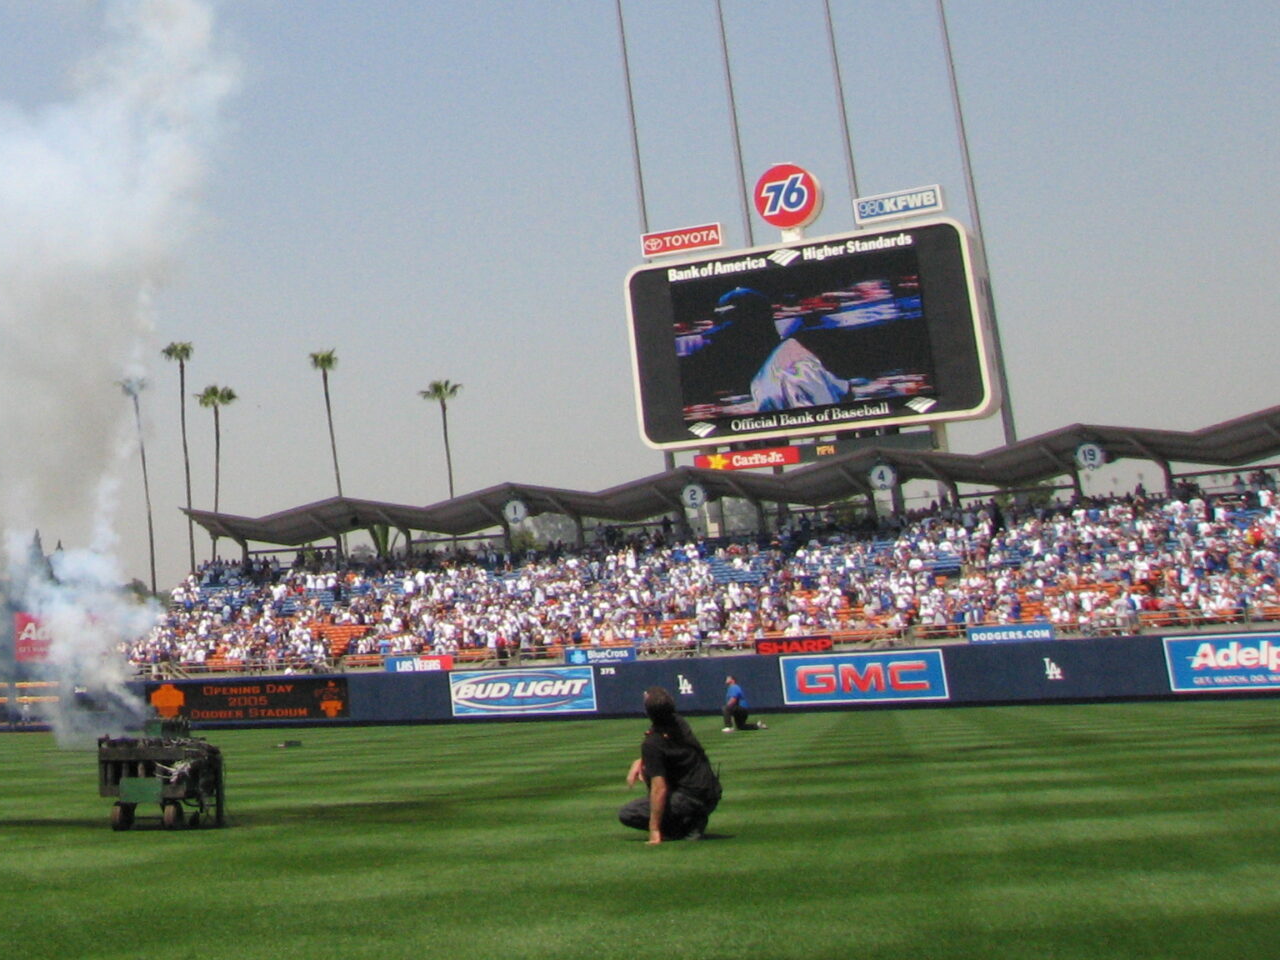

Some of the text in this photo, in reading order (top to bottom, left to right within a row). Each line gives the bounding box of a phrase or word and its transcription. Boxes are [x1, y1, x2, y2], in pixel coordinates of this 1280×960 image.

[761, 173, 808, 216] 76
[663, 230, 718, 247] TOYOTA
[803, 233, 912, 260] Higher Standards
[667, 257, 767, 282] Bank of America
[731, 402, 889, 431] Official Bank of Baseball
[732, 452, 785, 467] Carl's Jr.
[1083, 449, 1096, 461] 19
[878, 470, 885, 482] 4
[690, 490, 697, 501] 2
[972, 630, 1051, 642] DODGERS.COM
[758, 639, 833, 655] SHARP
[600, 667, 616, 676] 375
[1044, 657, 1063, 679] LA
[677, 674, 693, 694] LA
[796, 660, 930, 695] GMC
[458, 679, 588, 700] BUD LIGHT
[228, 696, 268, 707] 2005
